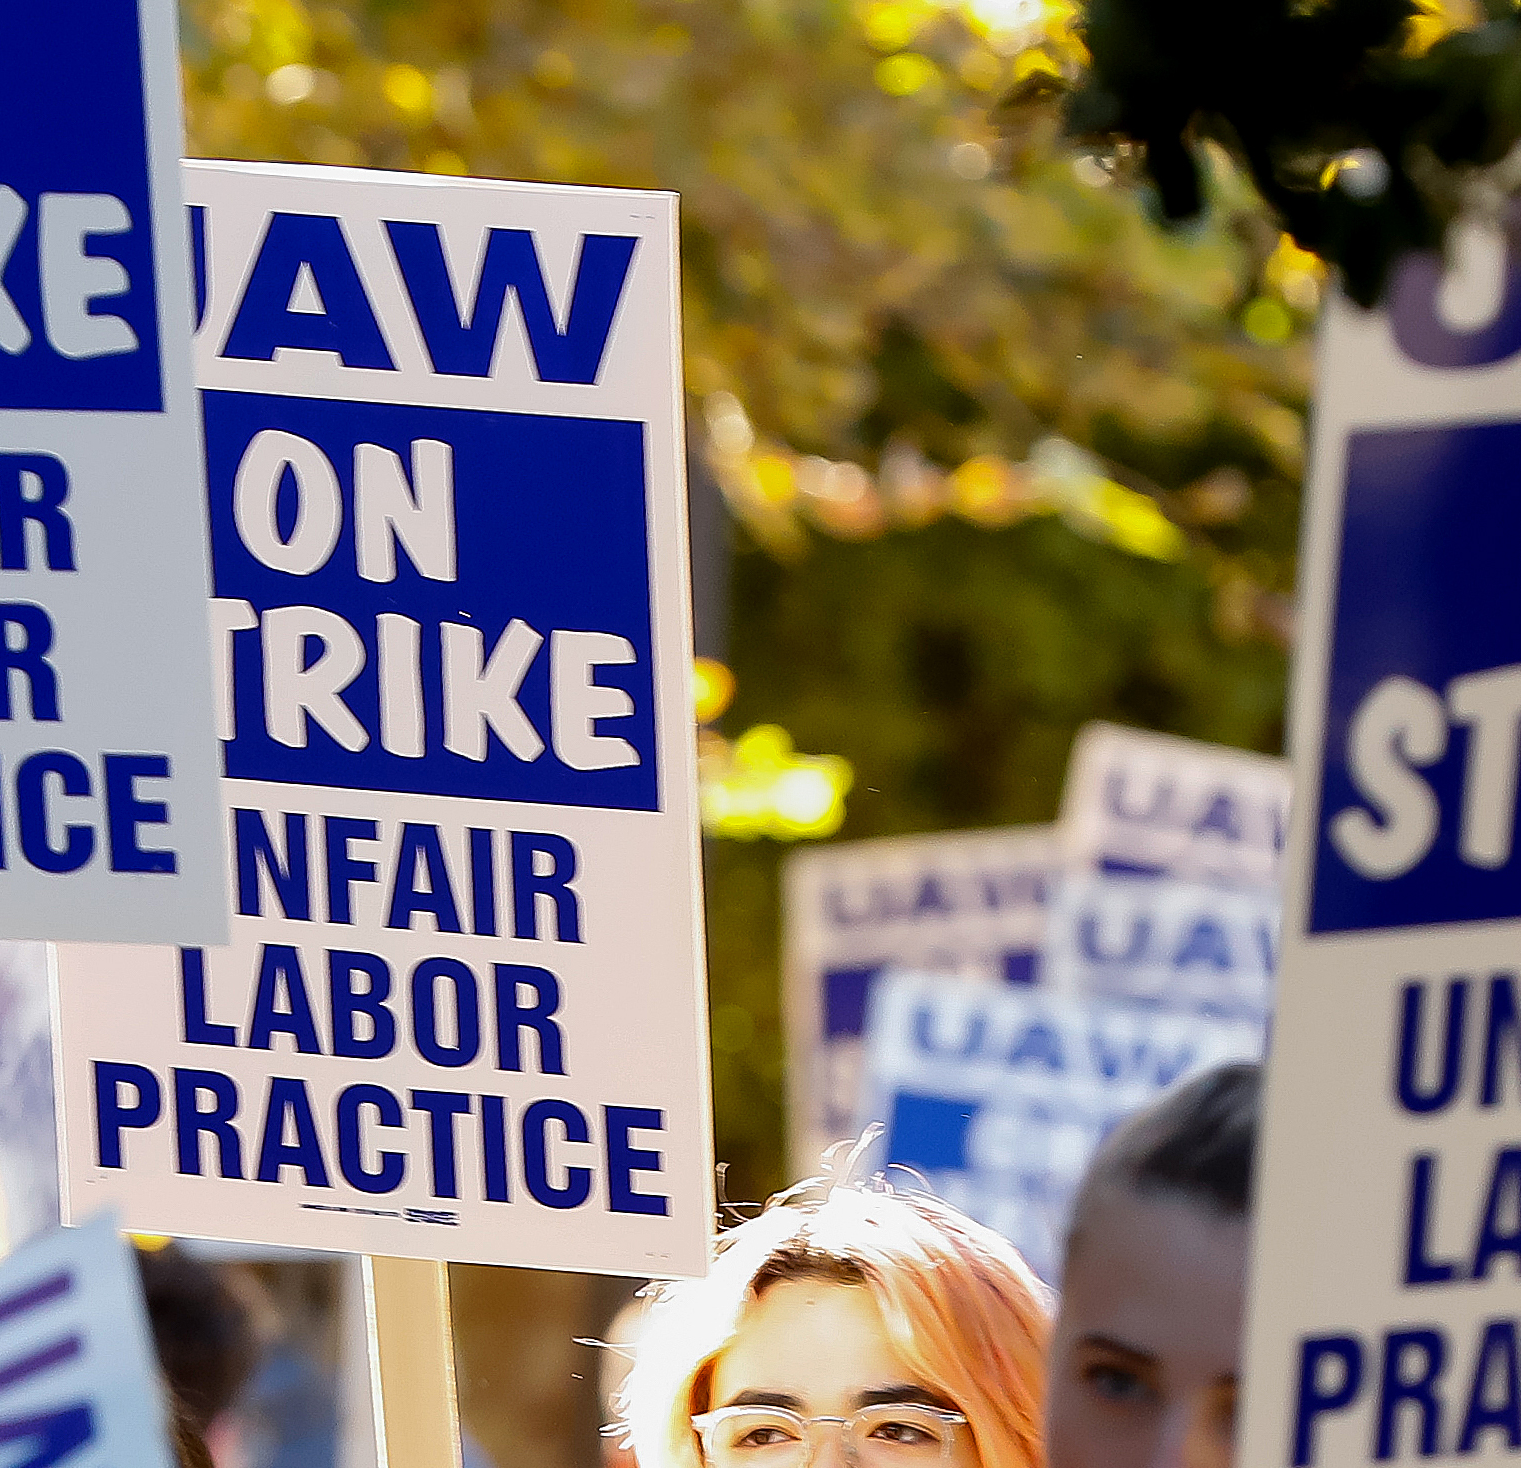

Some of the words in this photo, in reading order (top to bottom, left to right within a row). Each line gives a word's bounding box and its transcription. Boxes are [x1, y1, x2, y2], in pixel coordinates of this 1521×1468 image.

[189, 204, 642, 386] AW
[233, 429, 458, 584] ON
[208, 597, 641, 770] TRIKE
[231, 806, 587, 944] NFAIR
[181, 943, 571, 1076] LABOR
[92, 1059, 674, 1217] PRACTICE
